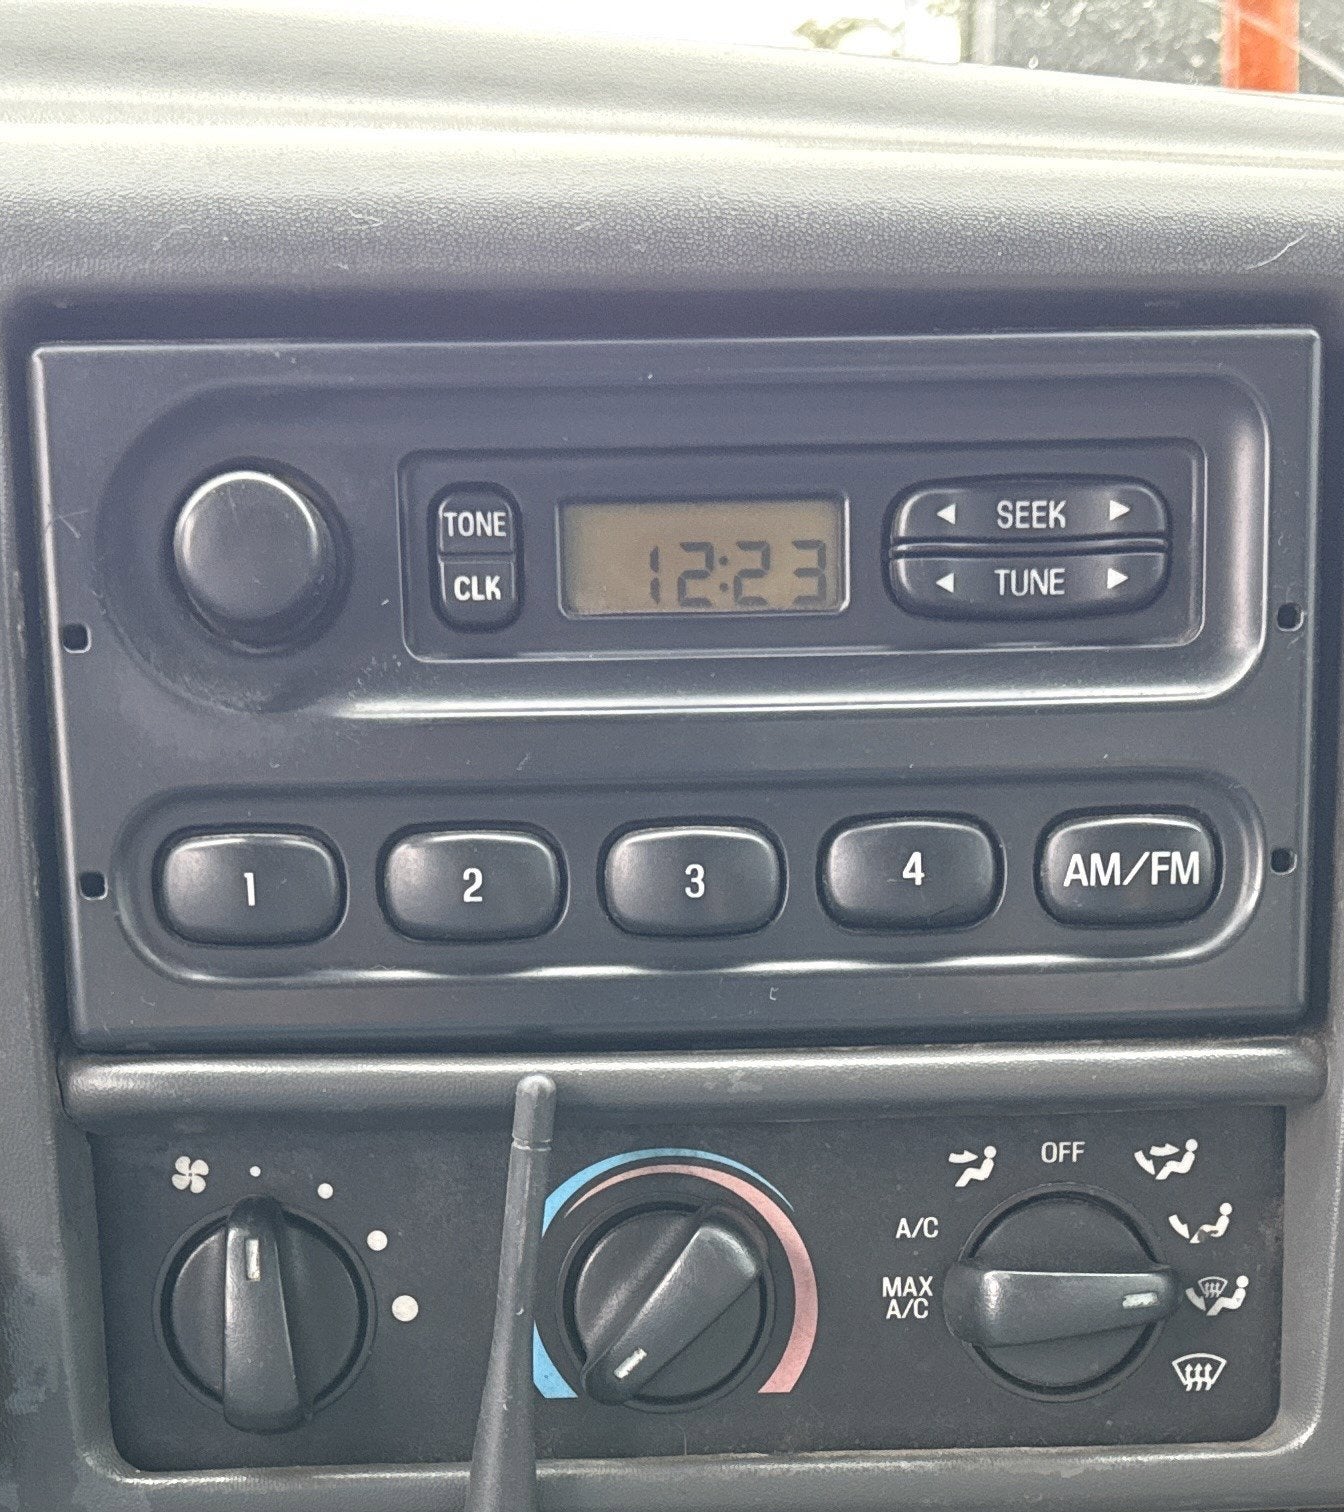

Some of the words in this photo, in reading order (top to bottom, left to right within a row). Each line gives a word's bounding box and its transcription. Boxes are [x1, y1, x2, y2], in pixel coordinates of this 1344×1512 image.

[443, 511, 507, 538] TONE
[996, 500, 1067, 529] SEEK
[649, 540, 827, 607] 12:23
[993, 567, 1068, 597] TUNE
[454, 574, 502, 603] CLK
[683, 863, 706, 900] 3
[901, 853, 926, 888] 4
[1062, 850, 1202, 888] AM/FM
[243, 871, 256, 906] 1
[462, 868, 484, 904] 2
[1041, 1141, 1086, 1164] OFF
[895, 1216, 940, 1240] A/C
[882, 1276, 934, 1298] MAX
[886, 1297, 930, 1320] A/C
